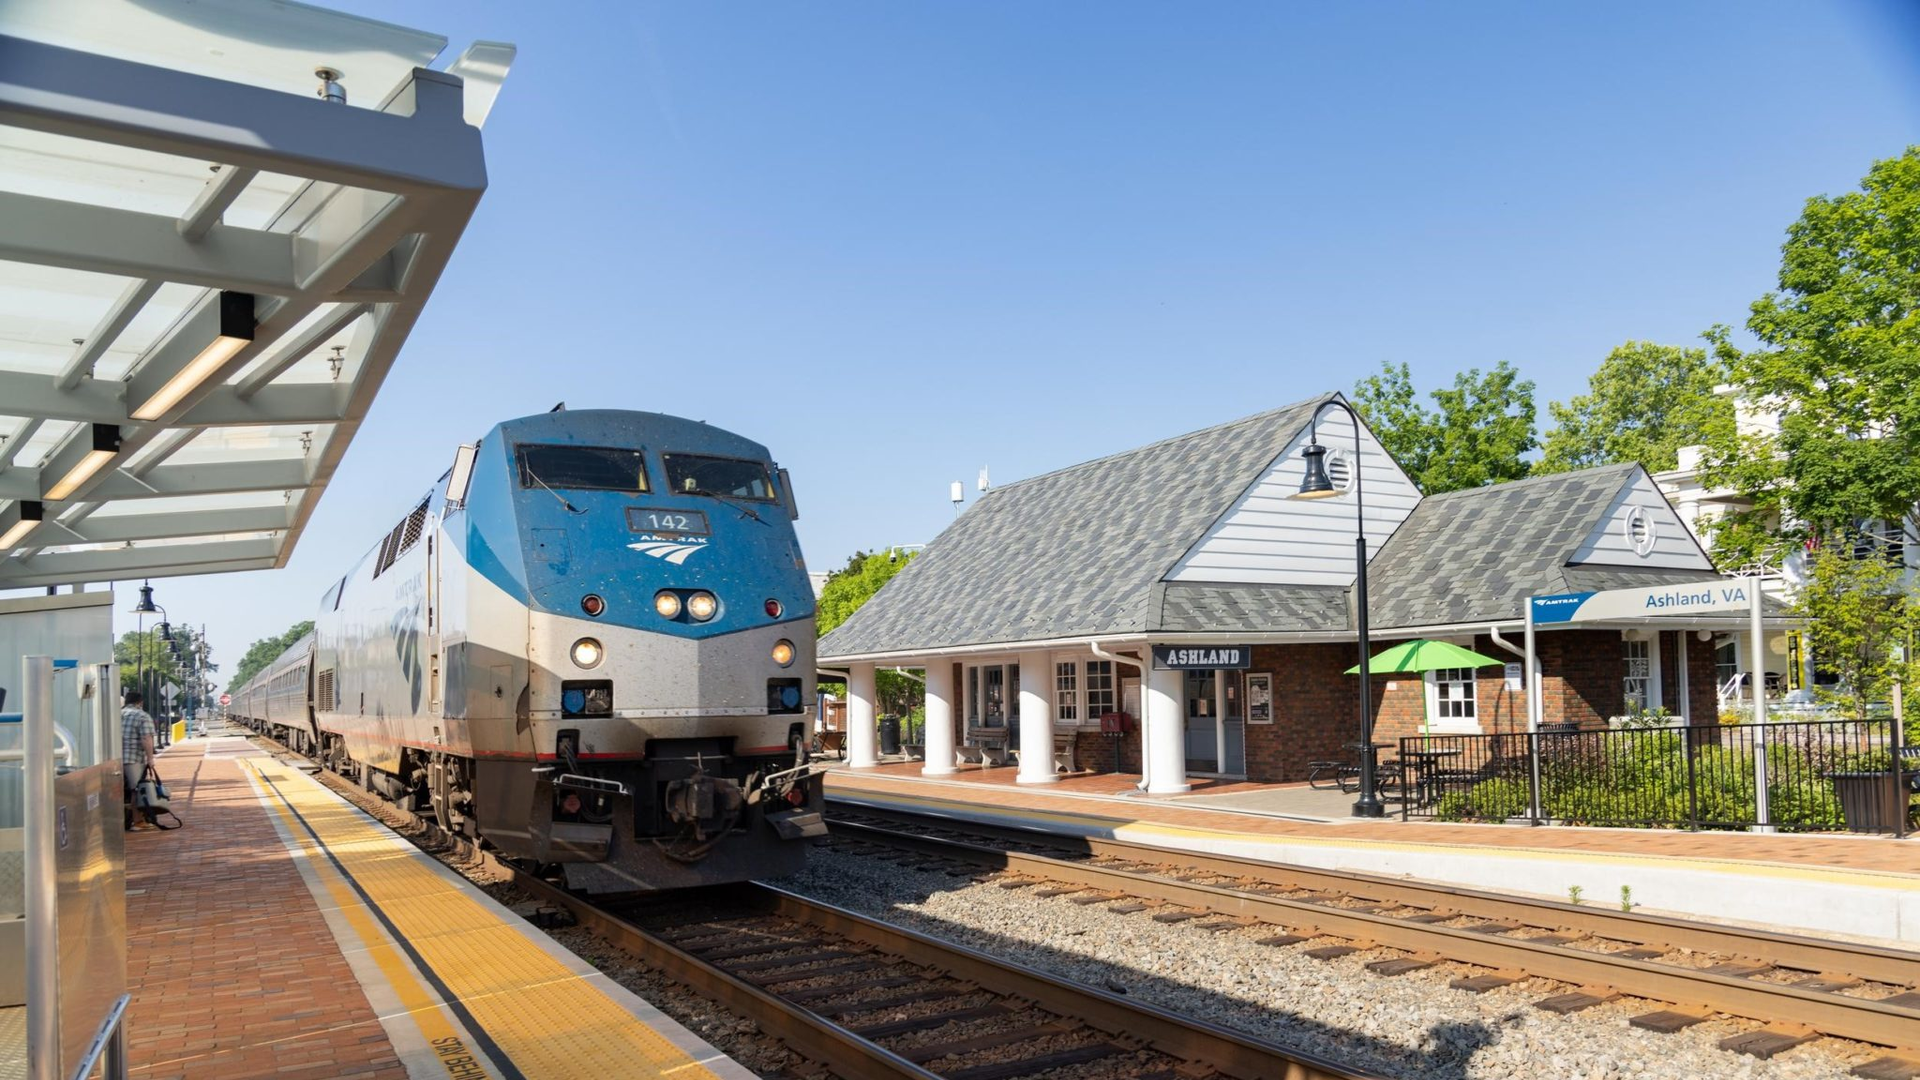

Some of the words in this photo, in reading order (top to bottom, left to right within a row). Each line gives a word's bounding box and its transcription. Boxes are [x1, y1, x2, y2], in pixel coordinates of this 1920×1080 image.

[648, 514, 689, 530] 142
[640, 535, 707, 543] AMRAK
[1646, 590, 1716, 609] Ashland,
[1722, 588, 1746, 602] VA
[1166, 649, 1240, 665] ASHLAND
[431, 1036, 469, 1057] STAY
